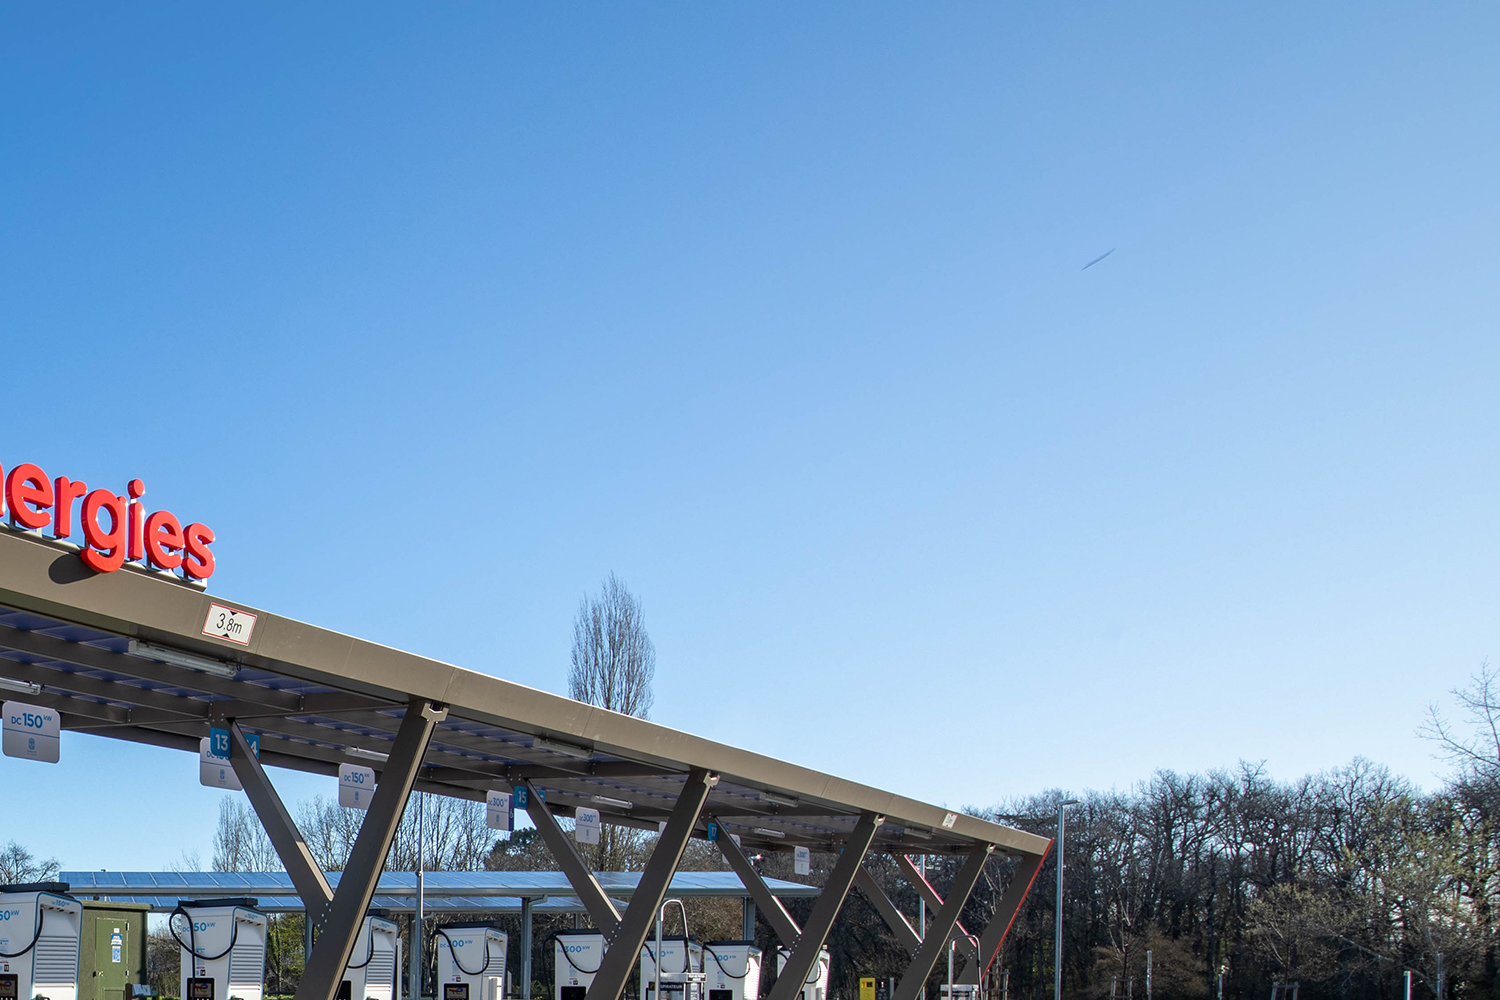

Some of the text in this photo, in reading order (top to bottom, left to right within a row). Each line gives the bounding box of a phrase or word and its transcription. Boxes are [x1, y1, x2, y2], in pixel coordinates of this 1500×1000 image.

[11, 716, 22, 726] DC
[22, 712, 43, 729] 150
[215, 733, 229, 751] 13
[351, 771, 365, 784] 150
[518, 790, 527, 804] 15
[192, 922, 207, 932] 50
